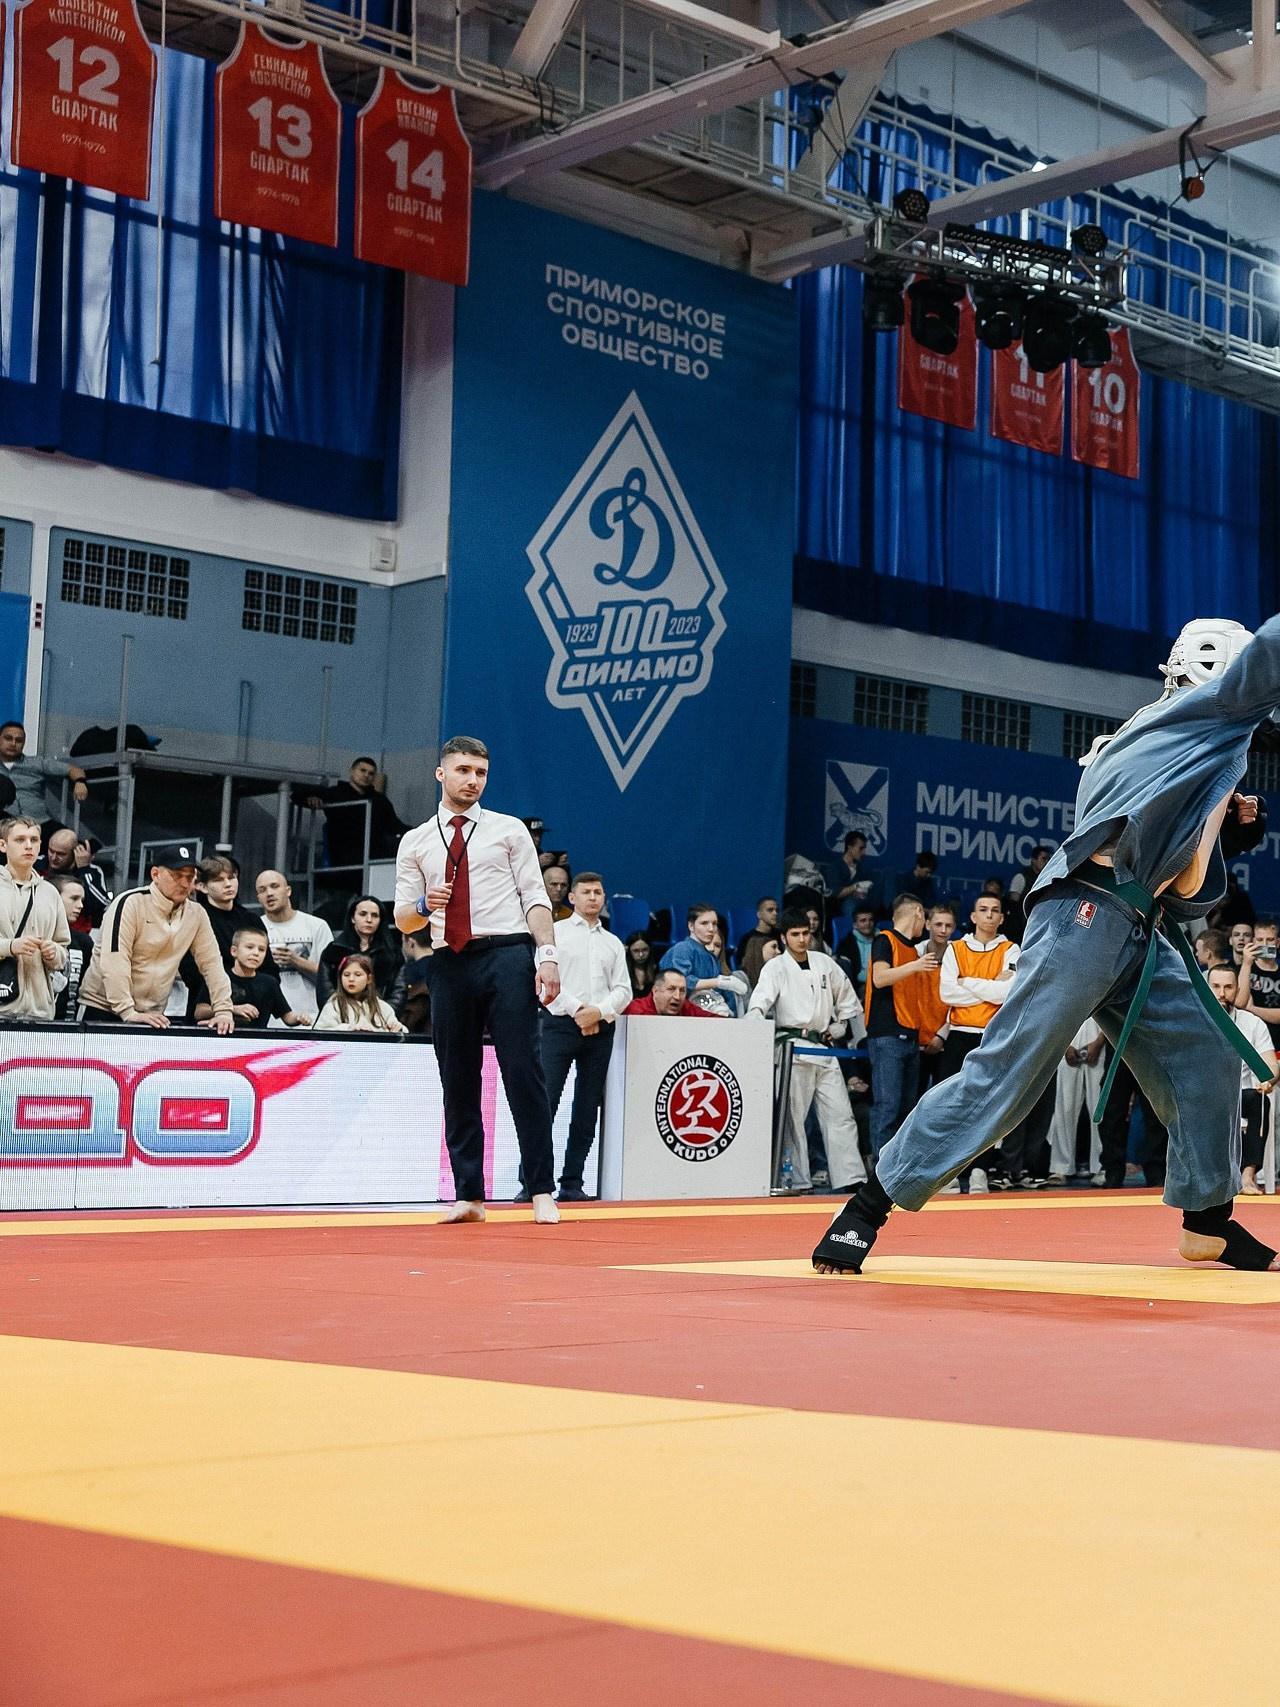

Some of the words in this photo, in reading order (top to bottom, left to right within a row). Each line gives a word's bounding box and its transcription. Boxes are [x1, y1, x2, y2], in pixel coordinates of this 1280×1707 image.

[46, 36, 120, 108] 12
[51, 95, 118, 132] СПАРТАК
[247, 97, 313, 158] 13
[250, 151, 309, 184] СПАРТАК
[386, 138, 447, 201] 14
[386, 192, 443, 224] СПАРТАК
[545, 263, 726, 336] ПРИМОРСКОЕ
[547, 291, 724, 360] СПОРТИВНОЕ
[561, 323, 710, 380] ОБЩЕСТВО
[1088, 368, 1126, 414] 10
[565, 622, 598, 644] 1923
[586, 604, 680, 657] 100
[667, 615, 701, 636] 2023
[562, 653, 698, 689] ДИНАМО
[612, 687, 646, 702] ЛЕТ
[916, 781, 1076, 833] МИНИСТЕ
[657, 1057, 709, 1135] INTERNATIONAL
[713, 1061, 741, 1139] FEDERATION
